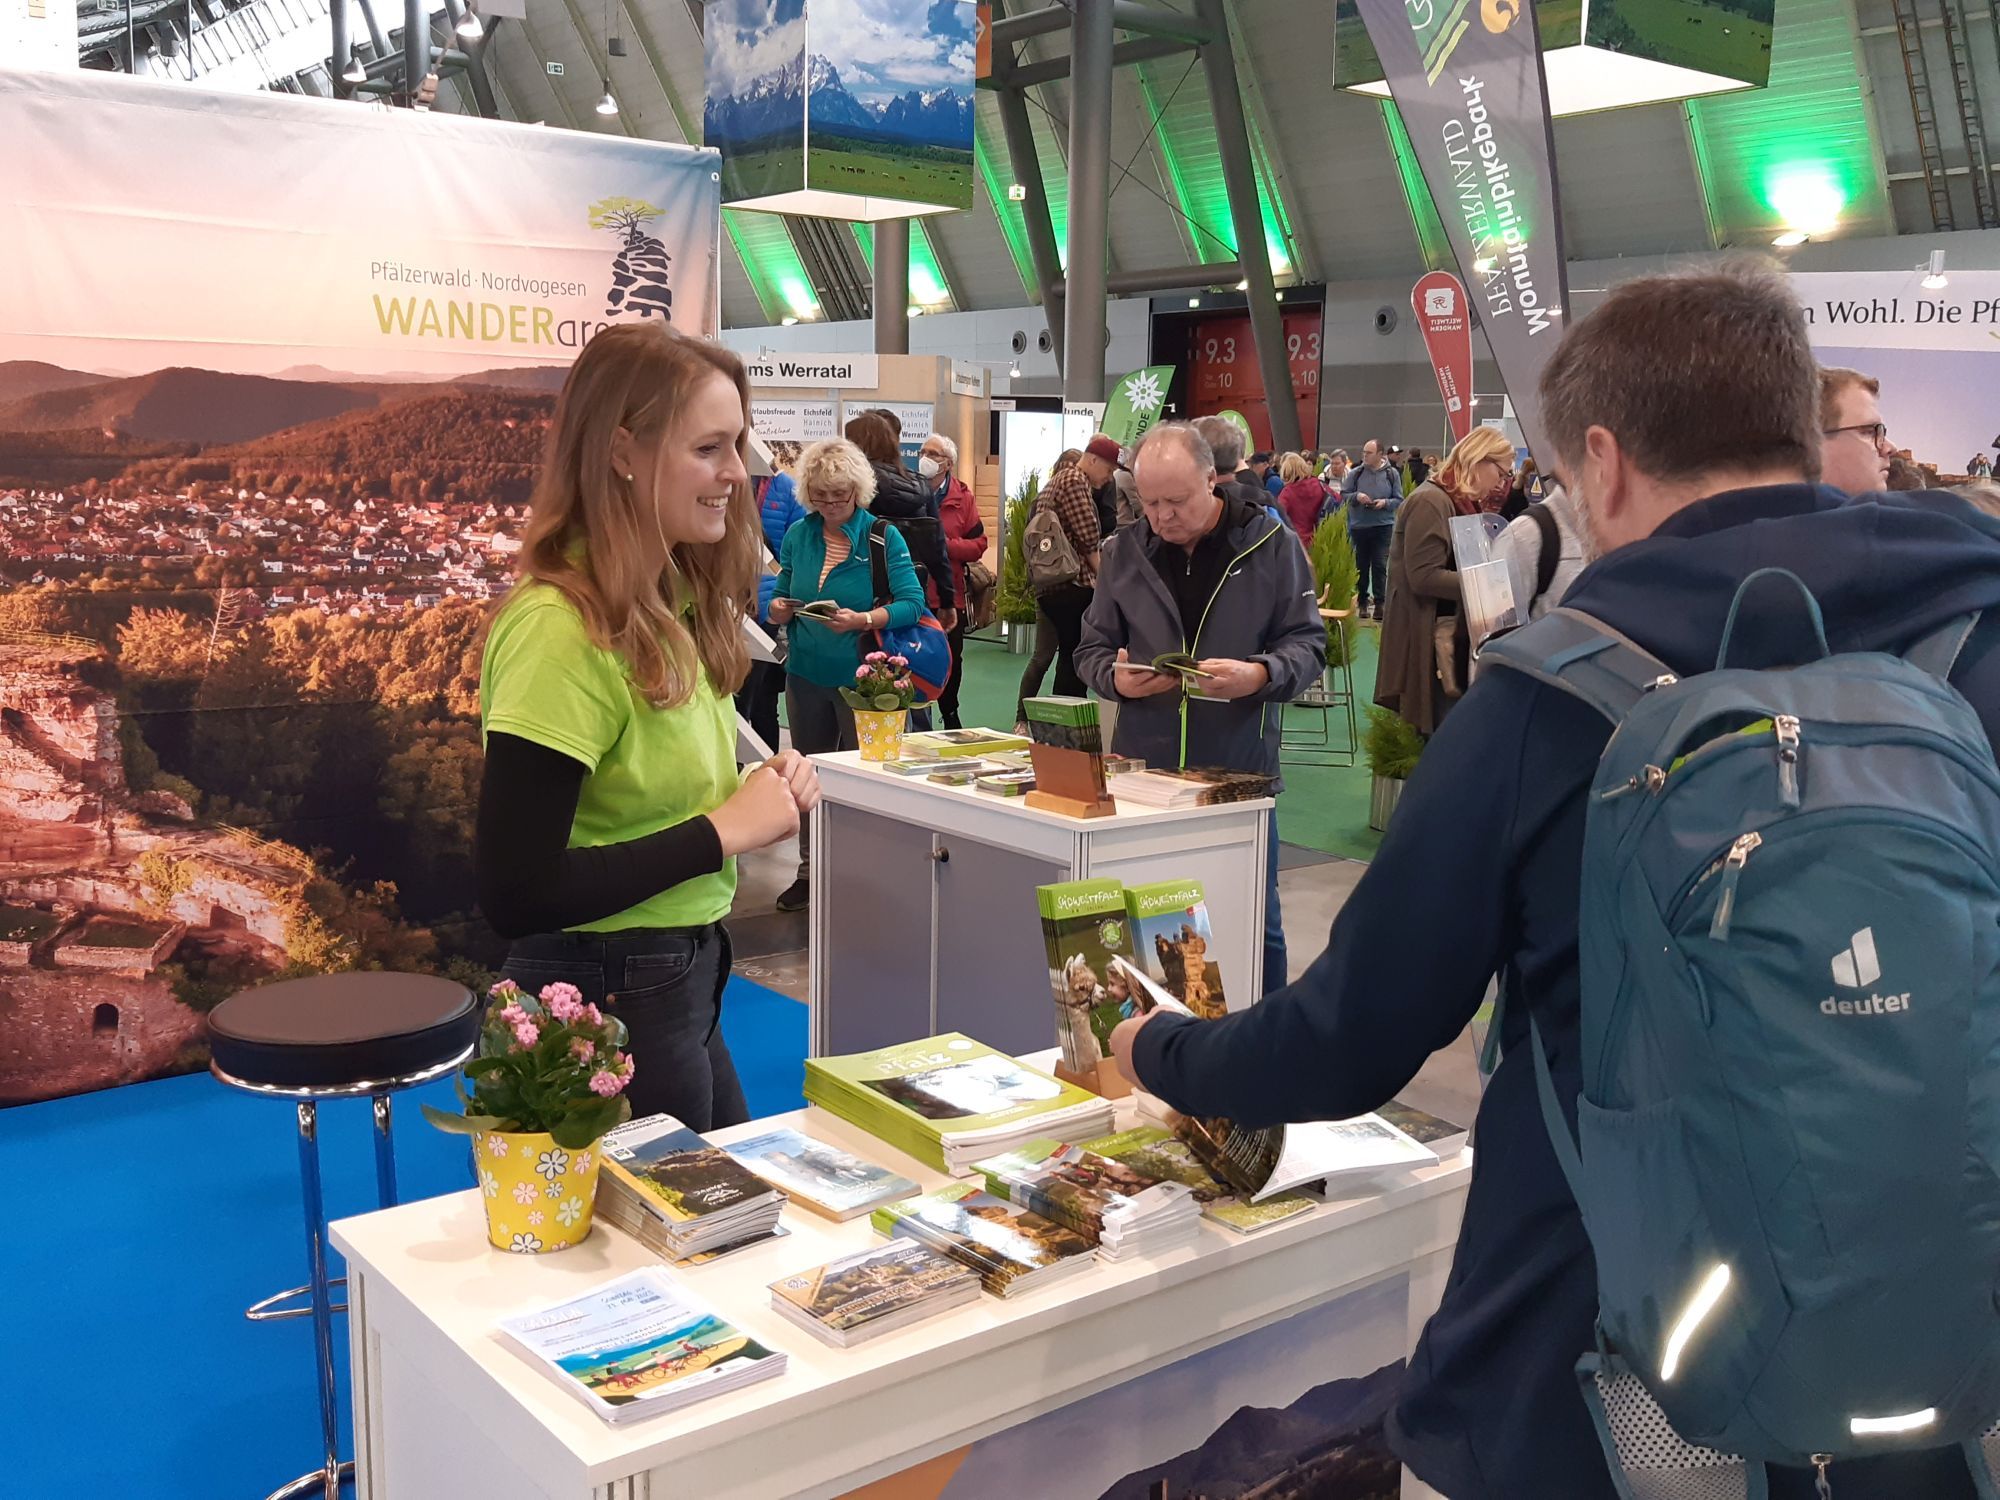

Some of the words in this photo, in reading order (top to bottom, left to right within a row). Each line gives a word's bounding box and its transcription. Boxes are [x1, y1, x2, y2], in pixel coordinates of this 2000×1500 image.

[371, 261, 471, 288] Pfälzerwald
[481, 272, 587, 298] Nordvogesen
[1824, 298, 1905, 324] Wohl.
[1914, 300, 1962, 324] Die
[1205, 337, 1236, 364] 9.3
[1287, 333, 1320, 361] 9.3
[779, 362, 852, 379] Werratal
[1301, 370, 1317, 386] 10
[1218, 373, 1233, 388] 10
[803, 409, 832, 417] Eichsfeld
[901, 410, 929, 419] Eichsfeld
[803, 429, 832, 437] Werratal
[1820, 993, 1910, 1015] deuter
